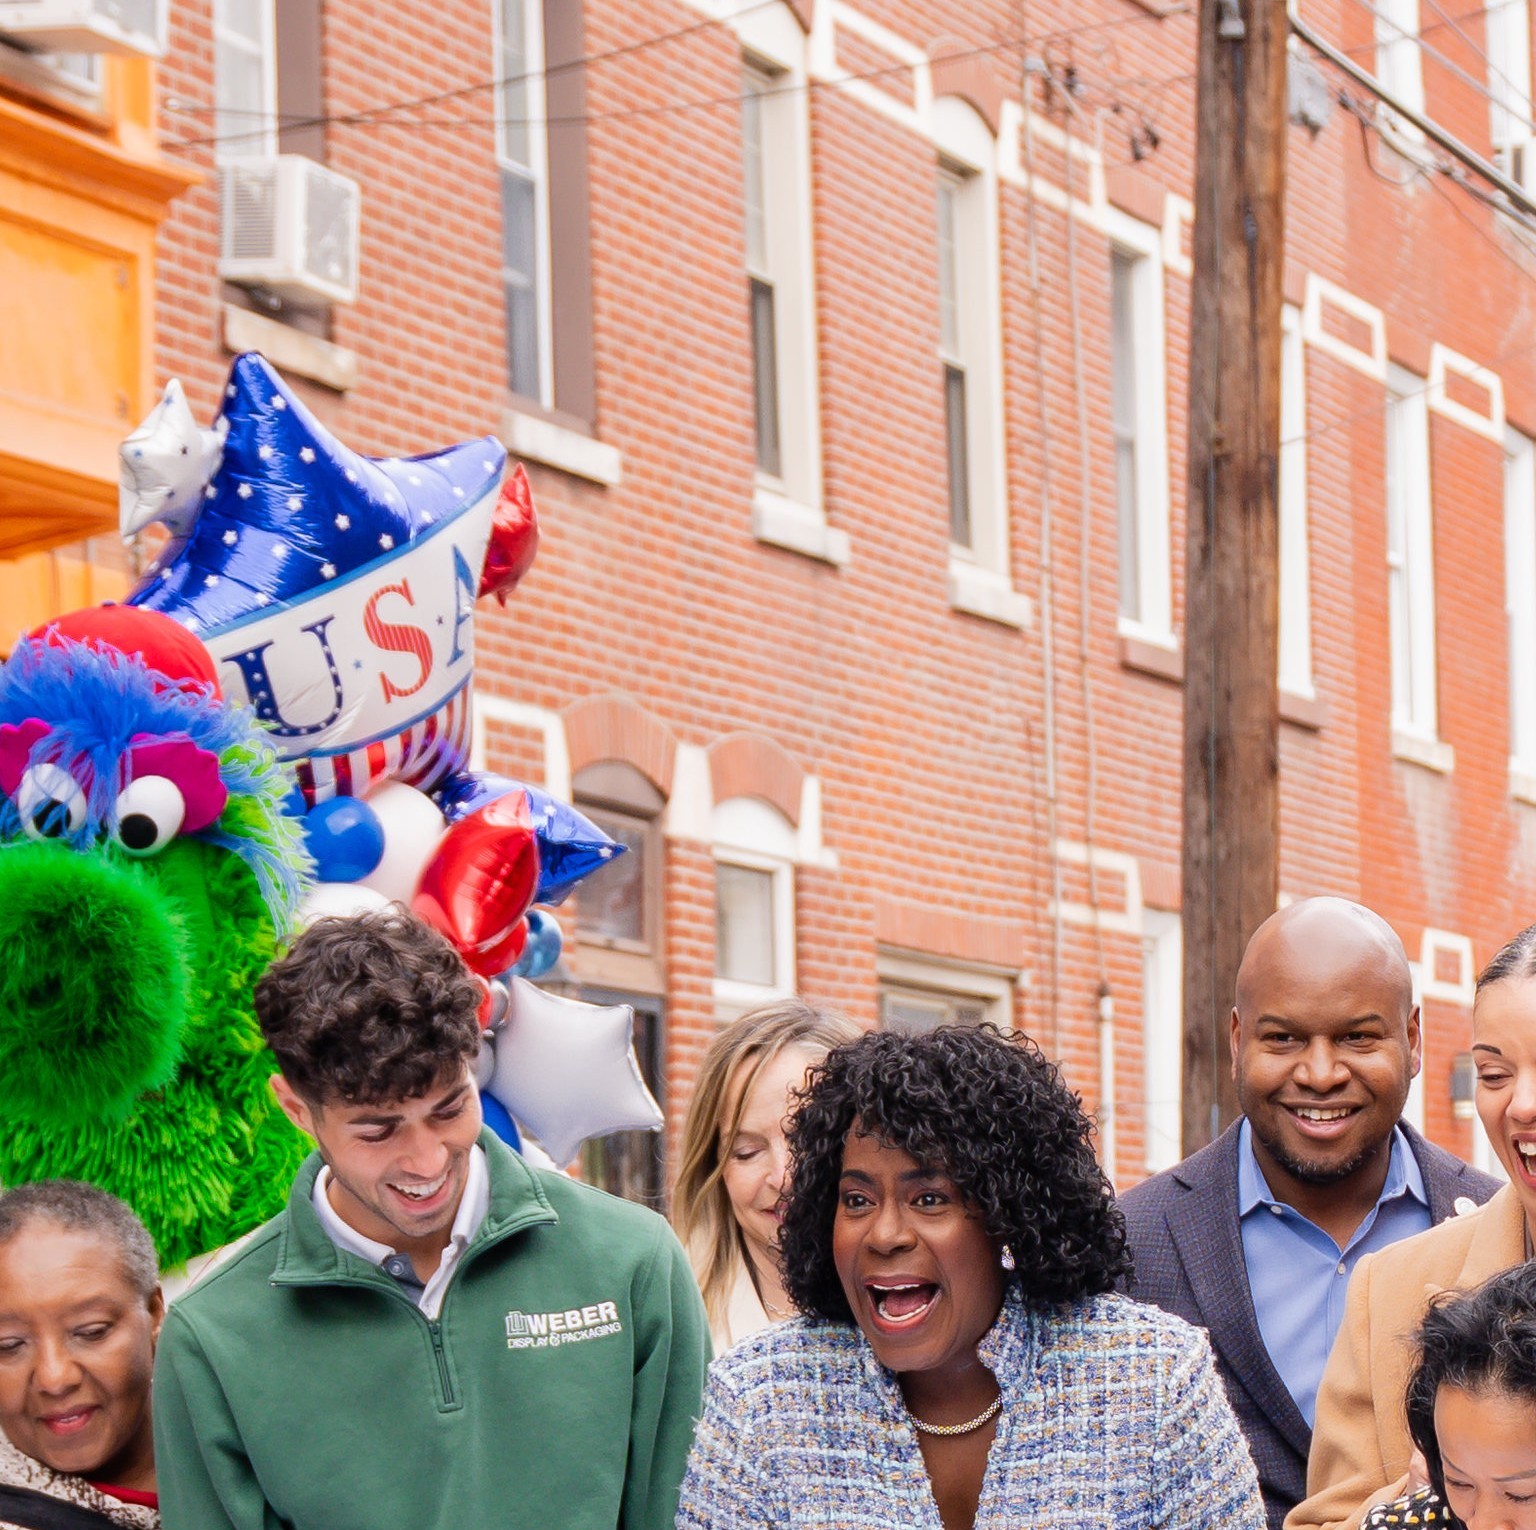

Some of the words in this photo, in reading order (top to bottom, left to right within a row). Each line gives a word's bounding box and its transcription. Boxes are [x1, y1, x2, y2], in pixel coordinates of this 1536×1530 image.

[527, 1301, 619, 1336] WEBER
[507, 1335, 548, 1349] DISPLAY
[561, 1322, 622, 1344] PACKAGING
